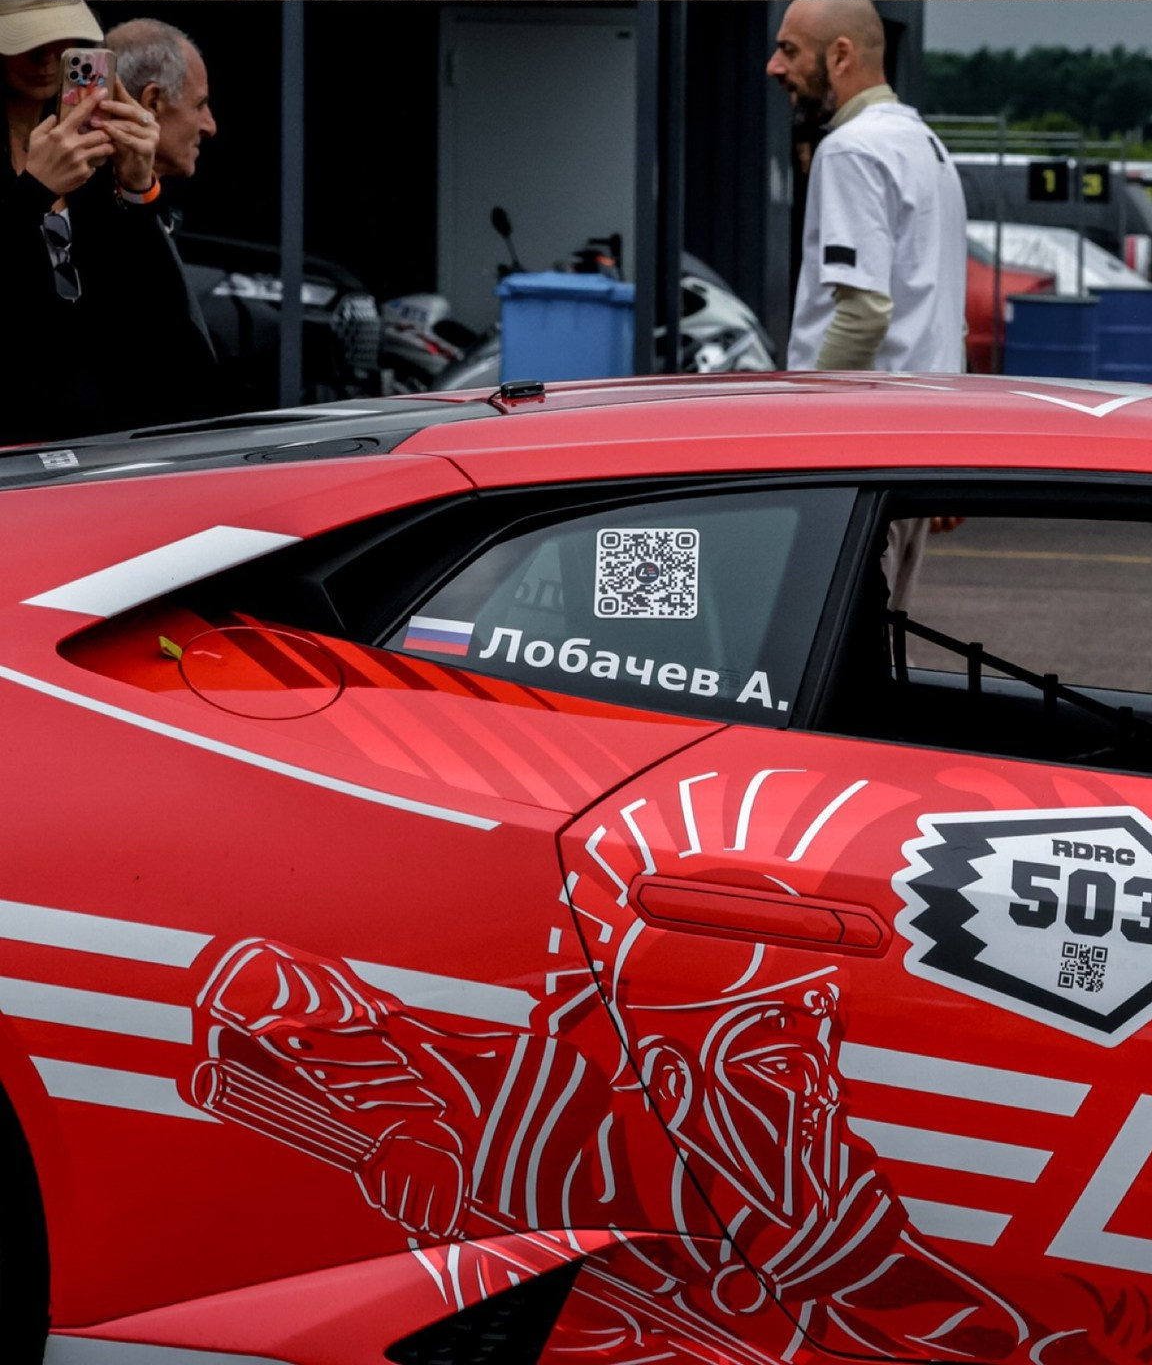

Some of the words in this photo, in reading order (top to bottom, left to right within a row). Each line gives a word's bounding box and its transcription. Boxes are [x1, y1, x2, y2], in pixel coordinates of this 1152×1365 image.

[1042, 169, 1056, 193] 1
[1082, 173, 1103, 197] 3
[480, 626, 720, 698] Лобачев
[735, 671, 789, 712] А.
[1052, 839, 1136, 867] RDRC
